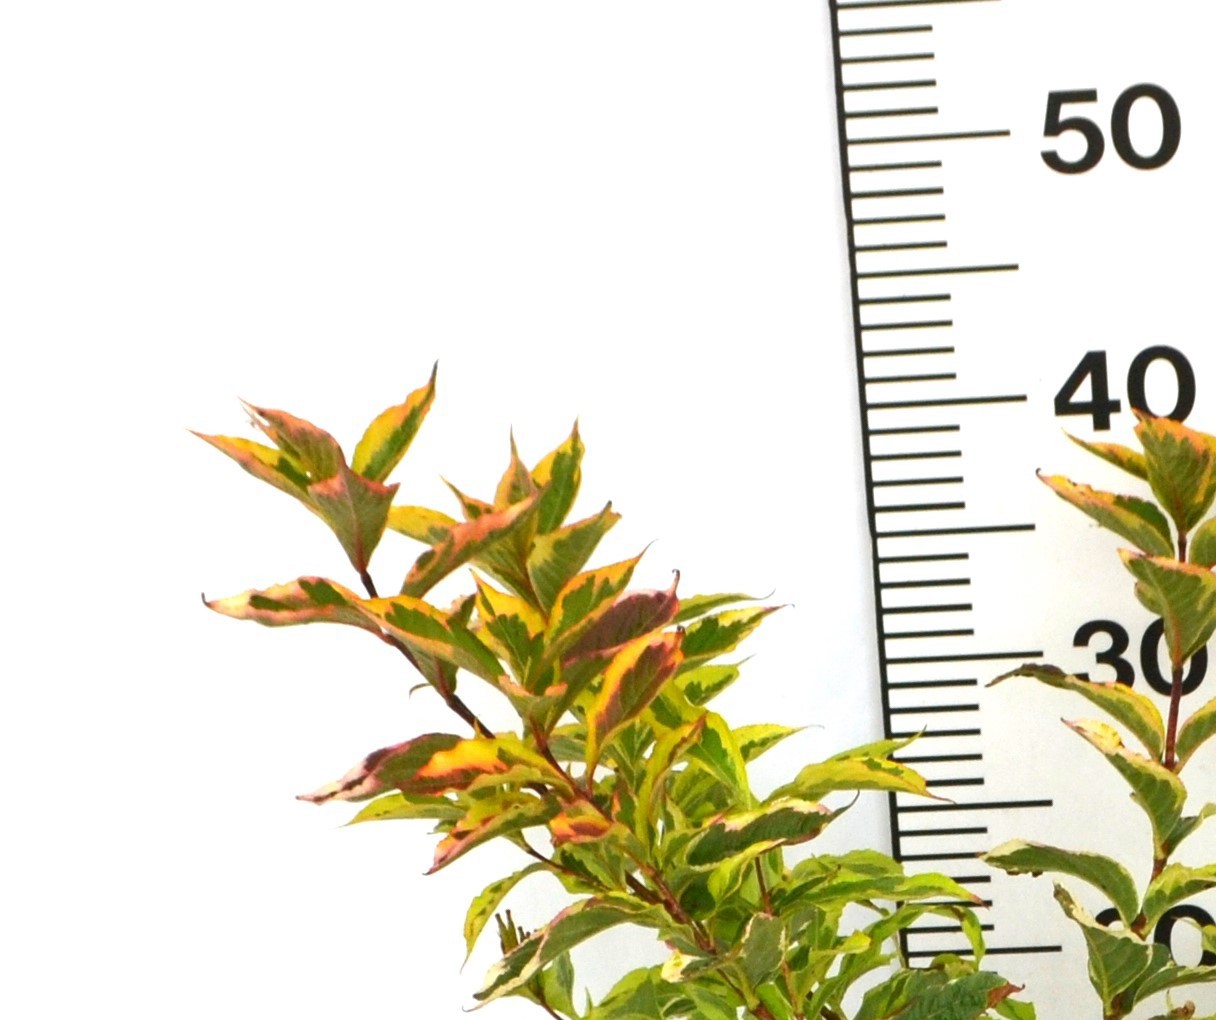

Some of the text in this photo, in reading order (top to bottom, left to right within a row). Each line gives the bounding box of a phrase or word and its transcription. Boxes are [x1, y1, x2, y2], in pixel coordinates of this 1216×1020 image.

[1040, 83, 1181, 174] 50
[1053, 345, 1196, 431] 40
[1073, 619, 1208, 697] 30
